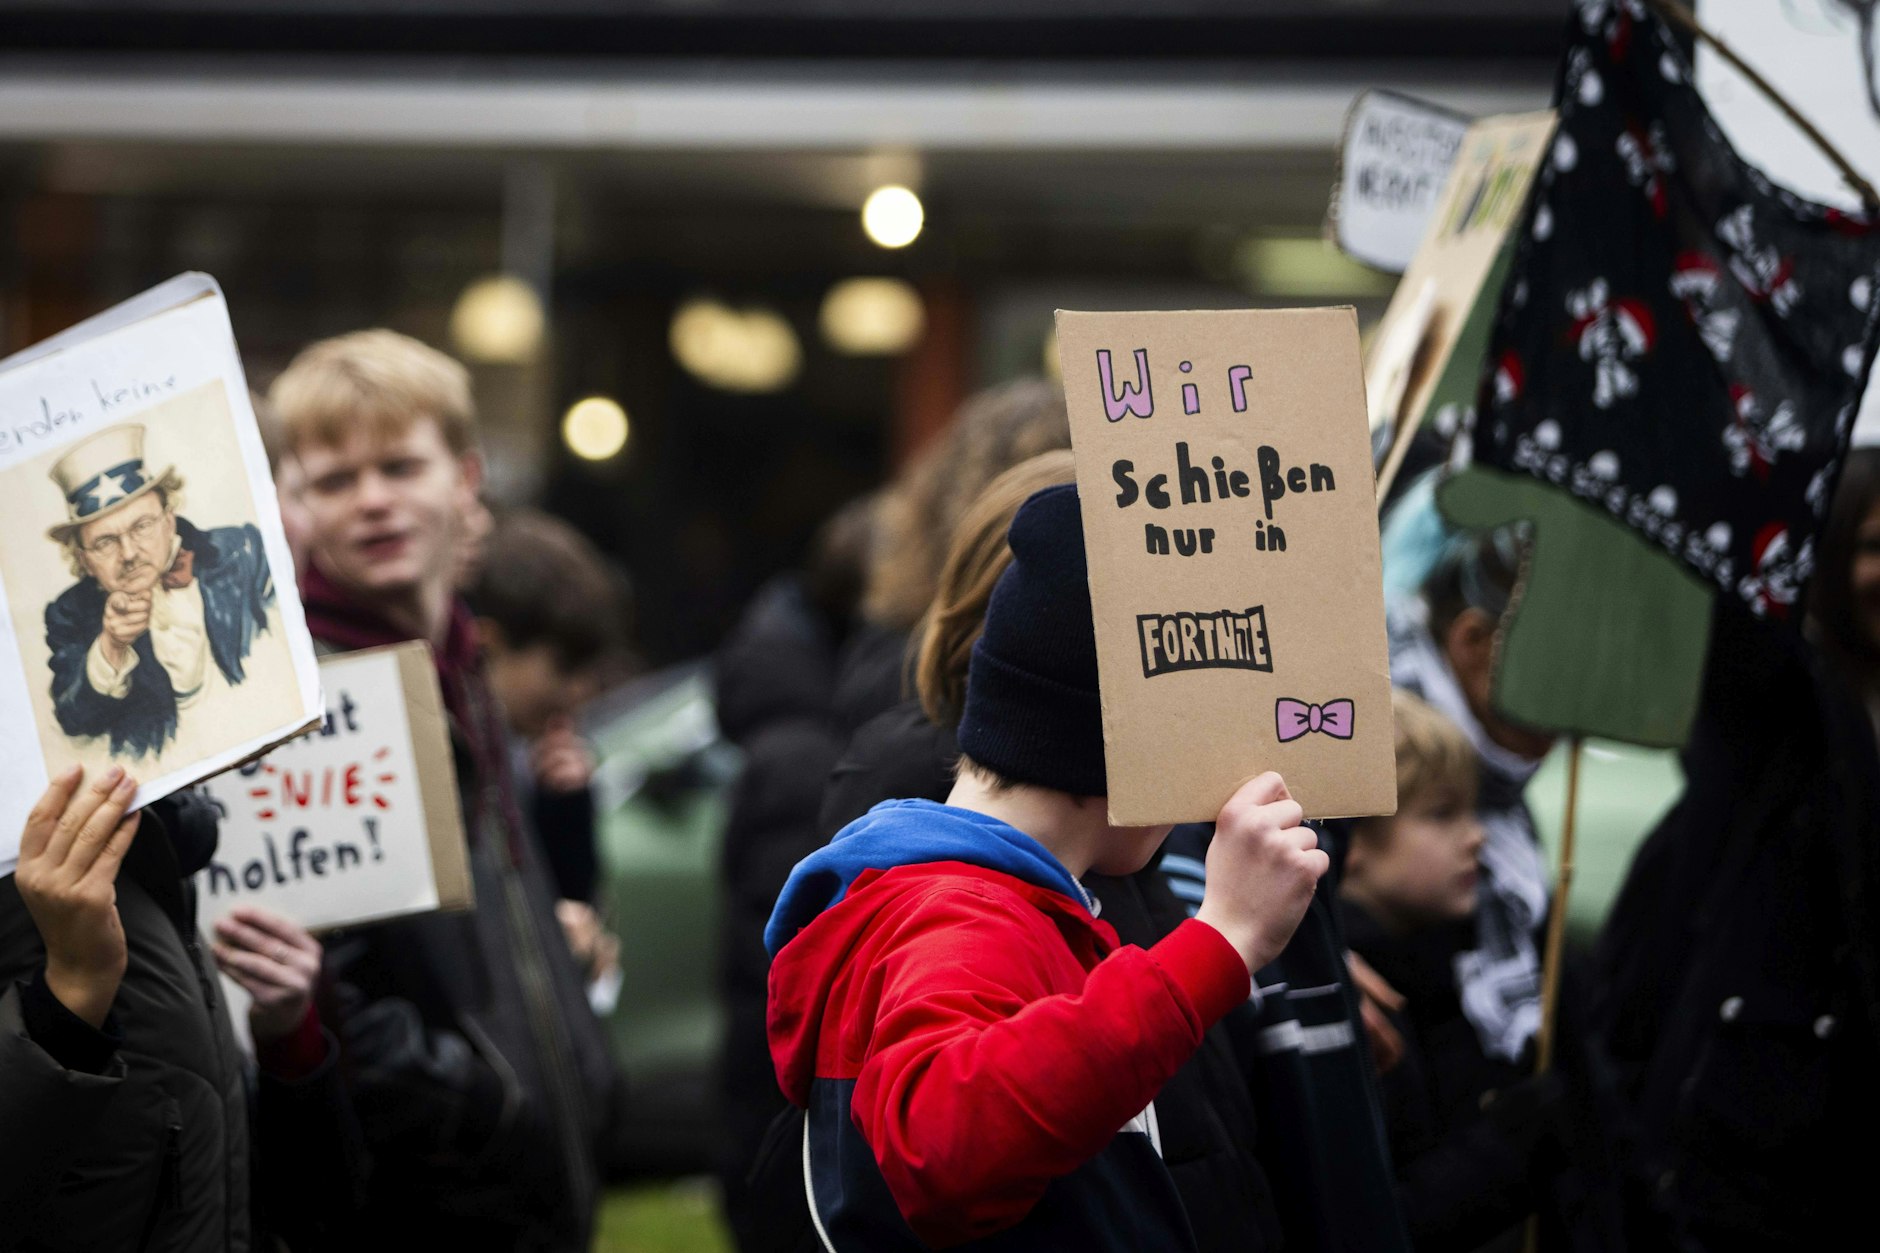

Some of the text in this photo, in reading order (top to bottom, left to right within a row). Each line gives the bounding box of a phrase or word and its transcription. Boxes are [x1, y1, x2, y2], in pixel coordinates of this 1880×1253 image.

[90, 374, 176, 412] keine
[1096, 348, 1253, 422] Wir
[1112, 441, 1336, 520] Schießen
[1145, 519, 1287, 557] nur in
[1137, 605, 1273, 679] FORTNITE
[283, 763, 362, 807] NIE
